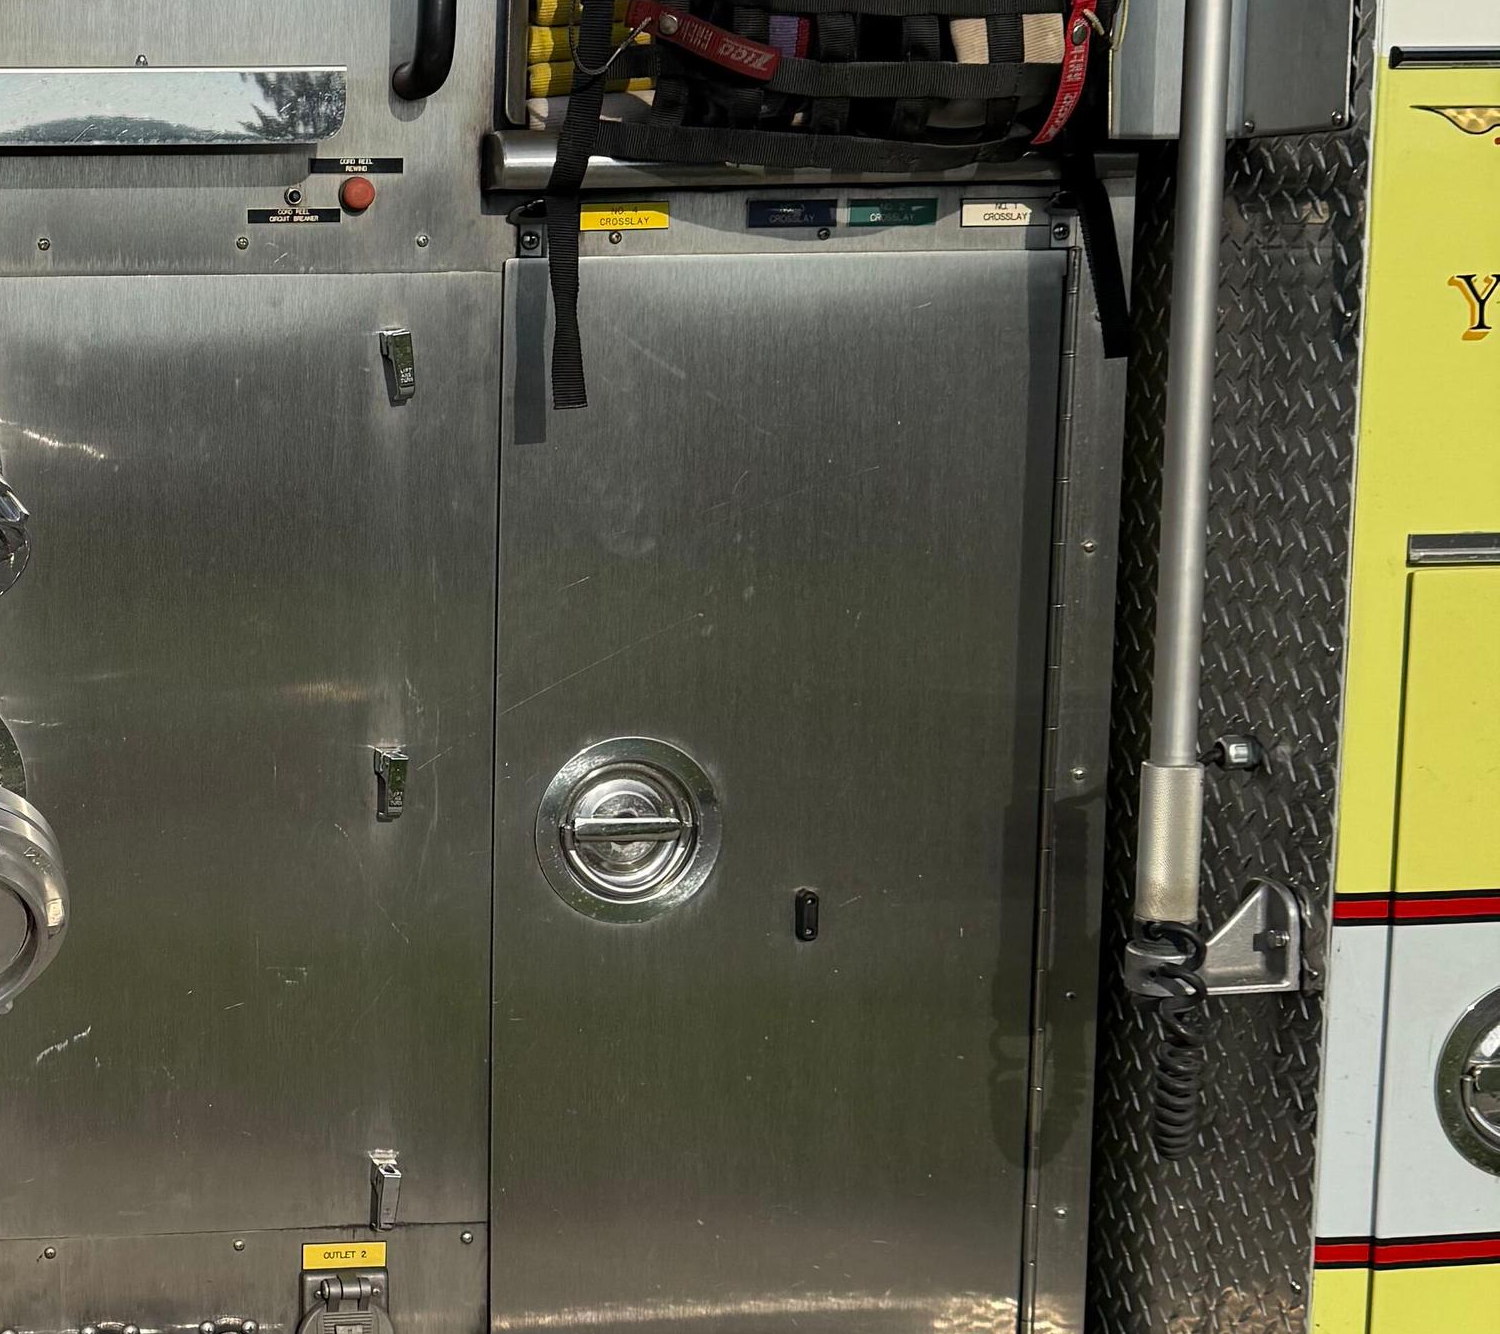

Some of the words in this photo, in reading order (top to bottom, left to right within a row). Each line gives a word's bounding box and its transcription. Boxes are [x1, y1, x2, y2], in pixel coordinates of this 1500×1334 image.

[599, 216, 650, 226] CROSSLAY
[983, 212, 1027, 221] CROSSLAY
[323, 1251, 356, 1259] OUTLET
